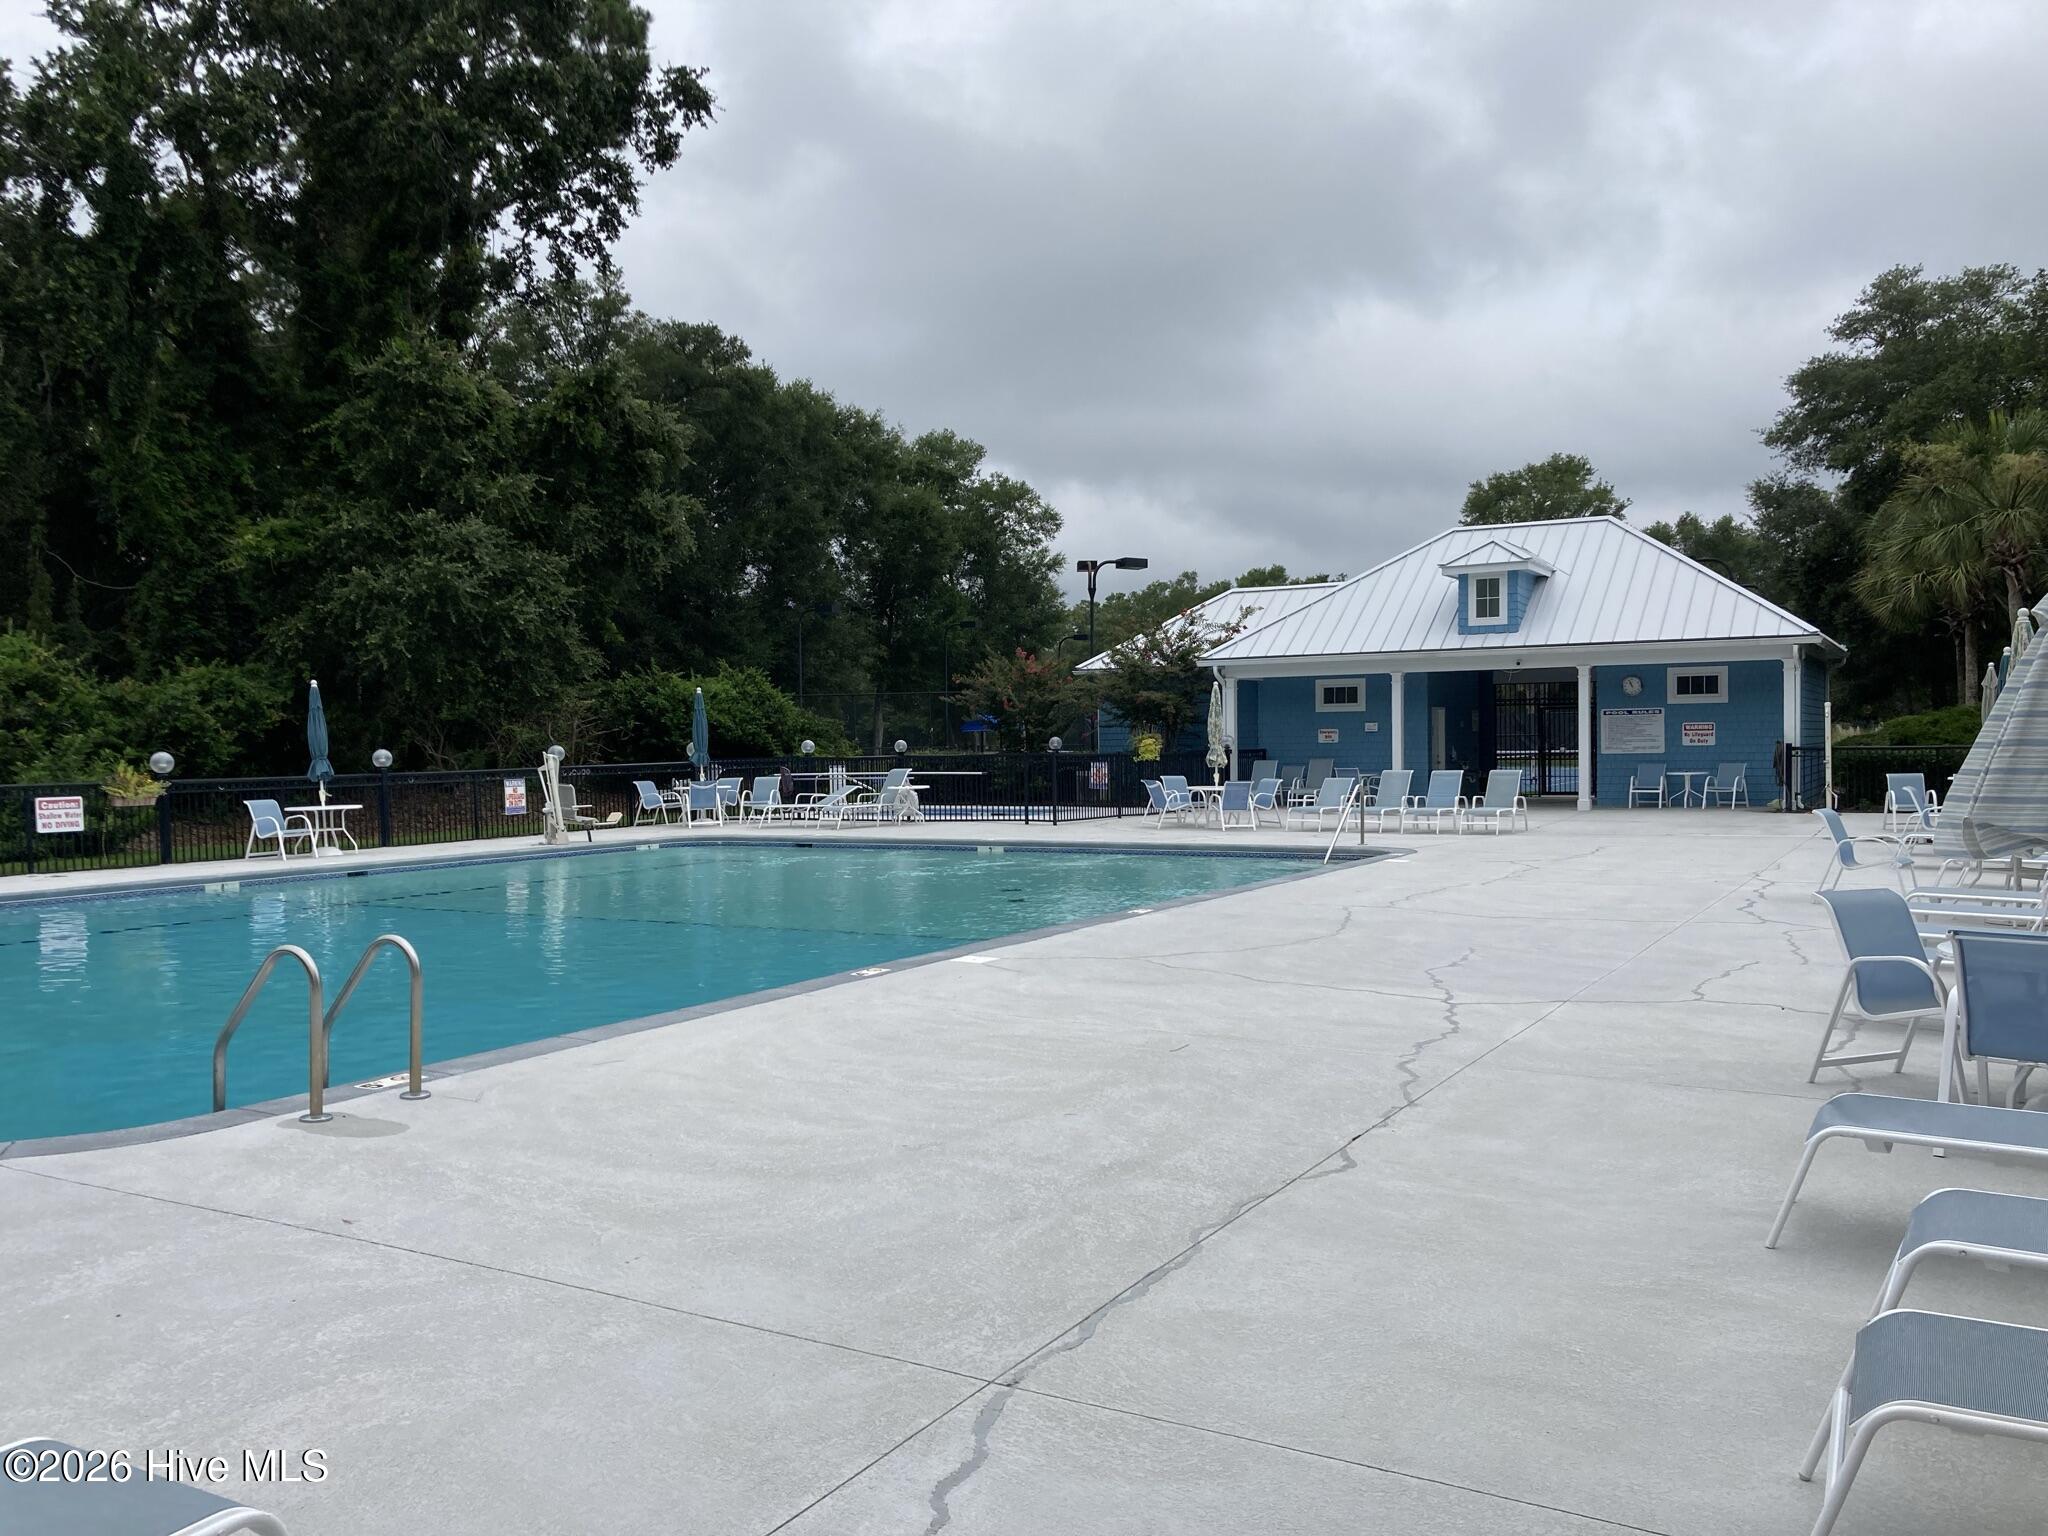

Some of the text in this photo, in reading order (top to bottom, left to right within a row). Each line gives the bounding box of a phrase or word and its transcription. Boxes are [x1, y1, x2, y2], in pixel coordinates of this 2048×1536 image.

[39, 812, 63, 820] Shallow
[41, 820, 80, 829] NO DIVING
